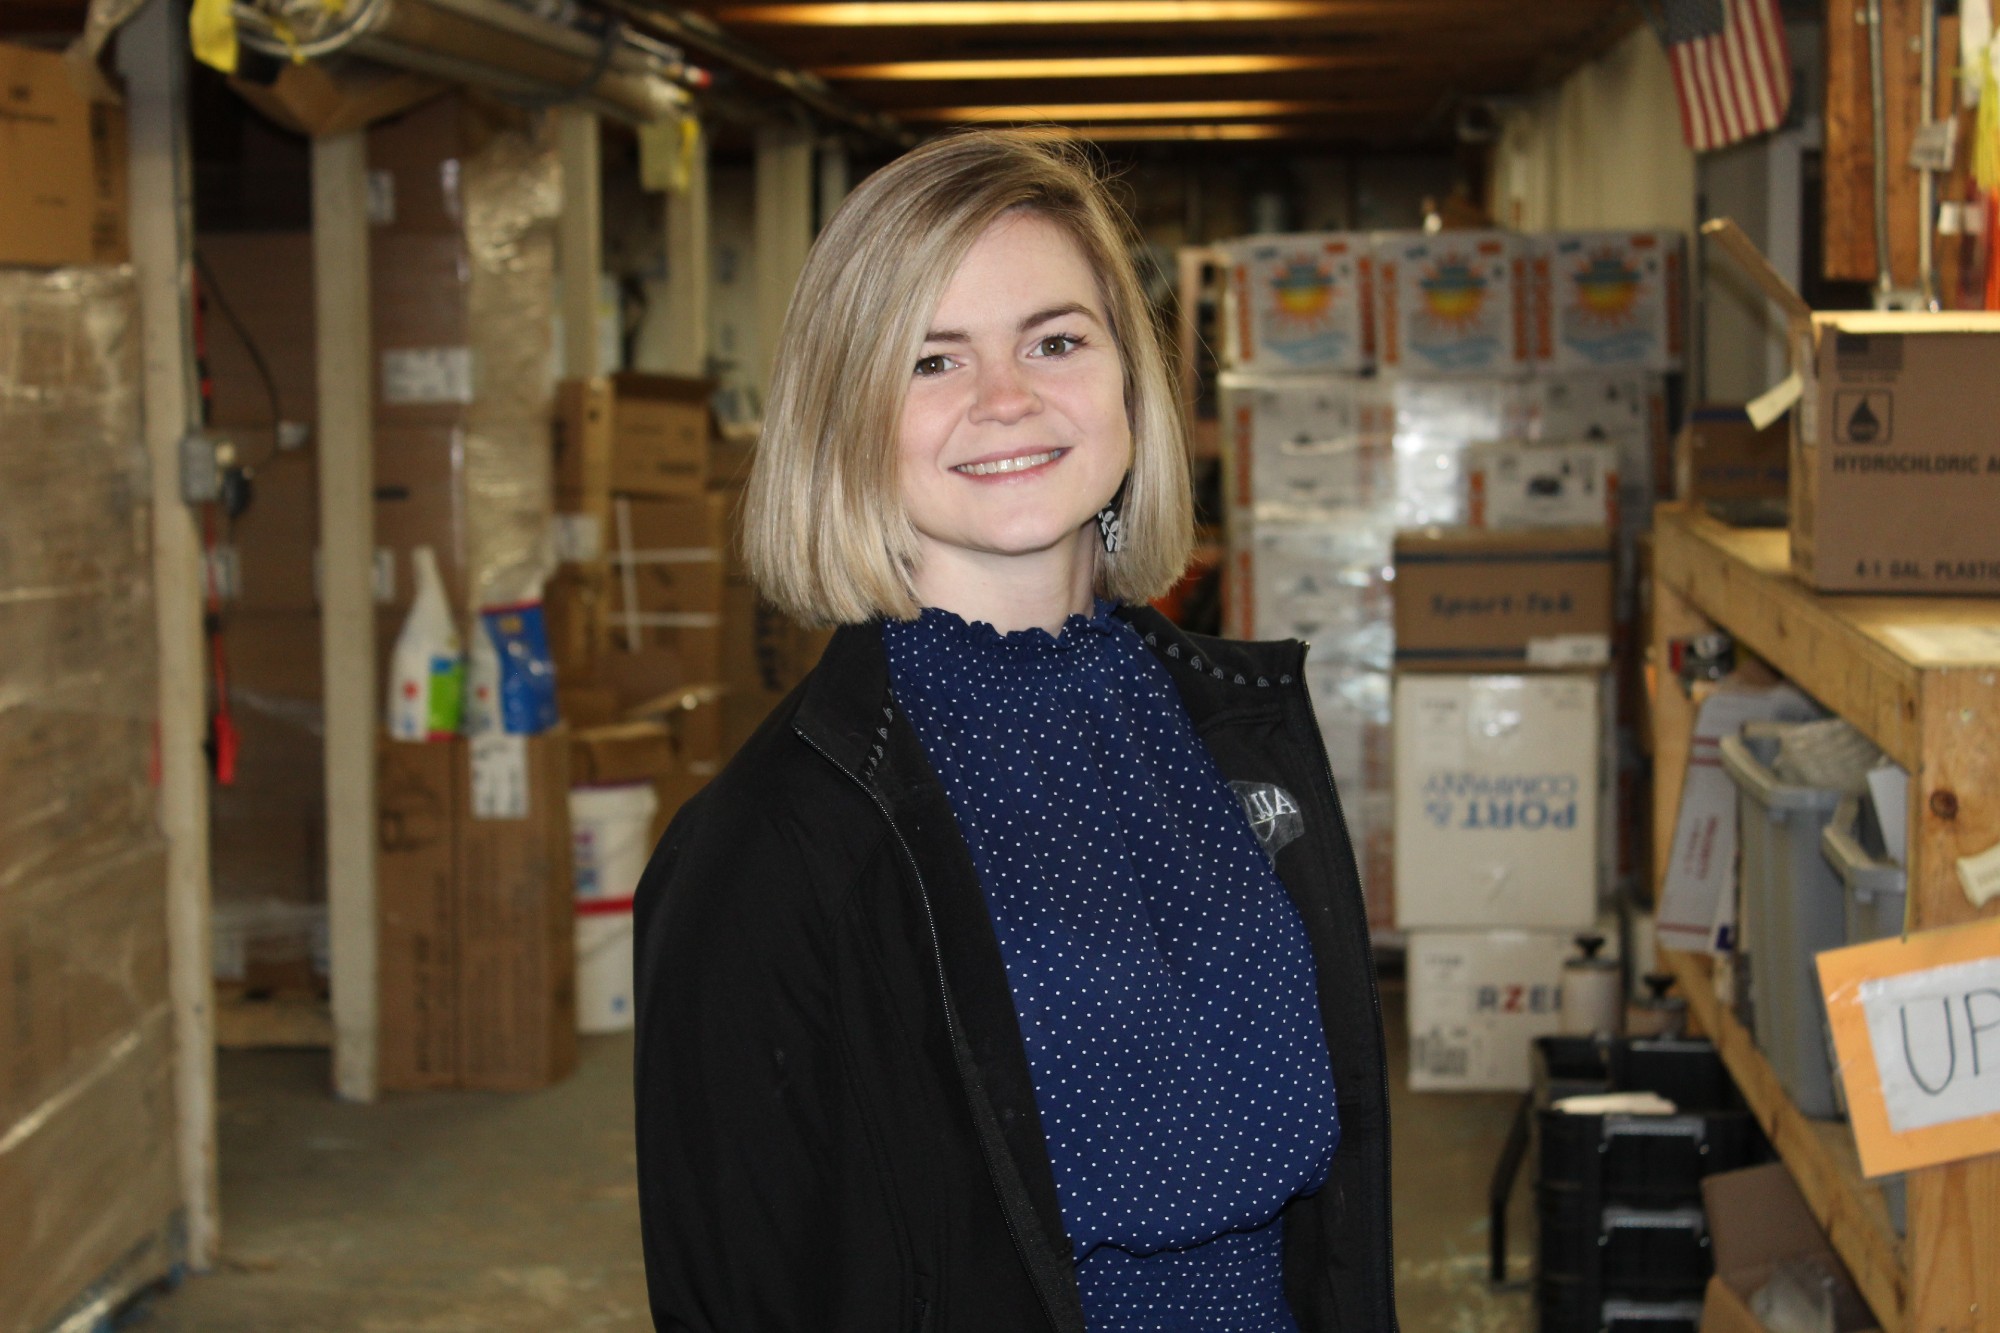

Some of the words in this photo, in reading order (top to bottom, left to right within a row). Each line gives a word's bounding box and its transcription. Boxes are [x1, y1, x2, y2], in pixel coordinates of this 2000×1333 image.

[1833, 454, 1979, 474] HYDROCHLORIC
[1986, 455, 2000, 473] A
[1423, 771, 1579, 797] COMPANY
[1424, 801, 1453, 827] &
[1461, 800, 1577, 829] PORT
[1899, 988, 2000, 1096] UP
